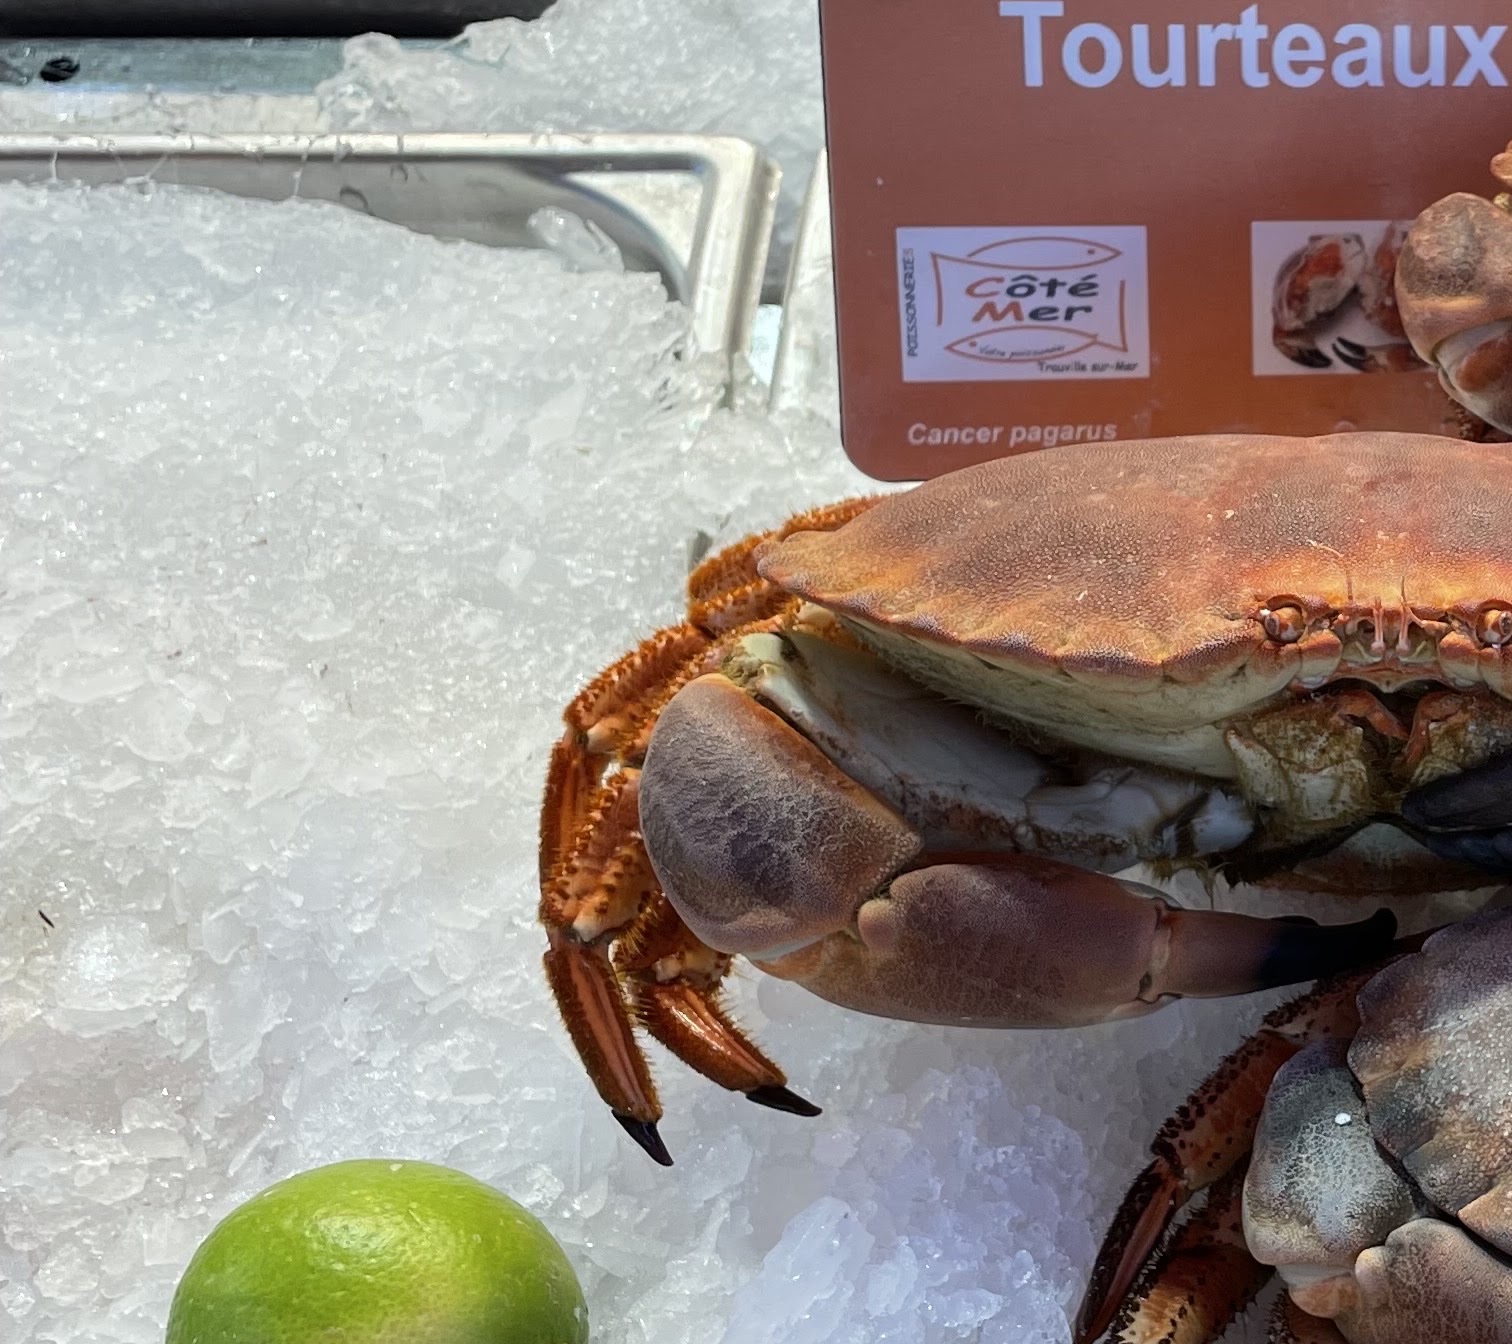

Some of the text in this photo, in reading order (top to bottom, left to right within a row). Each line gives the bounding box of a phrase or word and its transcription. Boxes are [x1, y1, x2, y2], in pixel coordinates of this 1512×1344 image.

[999, 0, 1507, 89] Tourteaux
[965, 273, 1099, 298] Côté
[972, 301, 1093, 323] Mer
[907, 421, 1118, 448] Cancer pagarus
